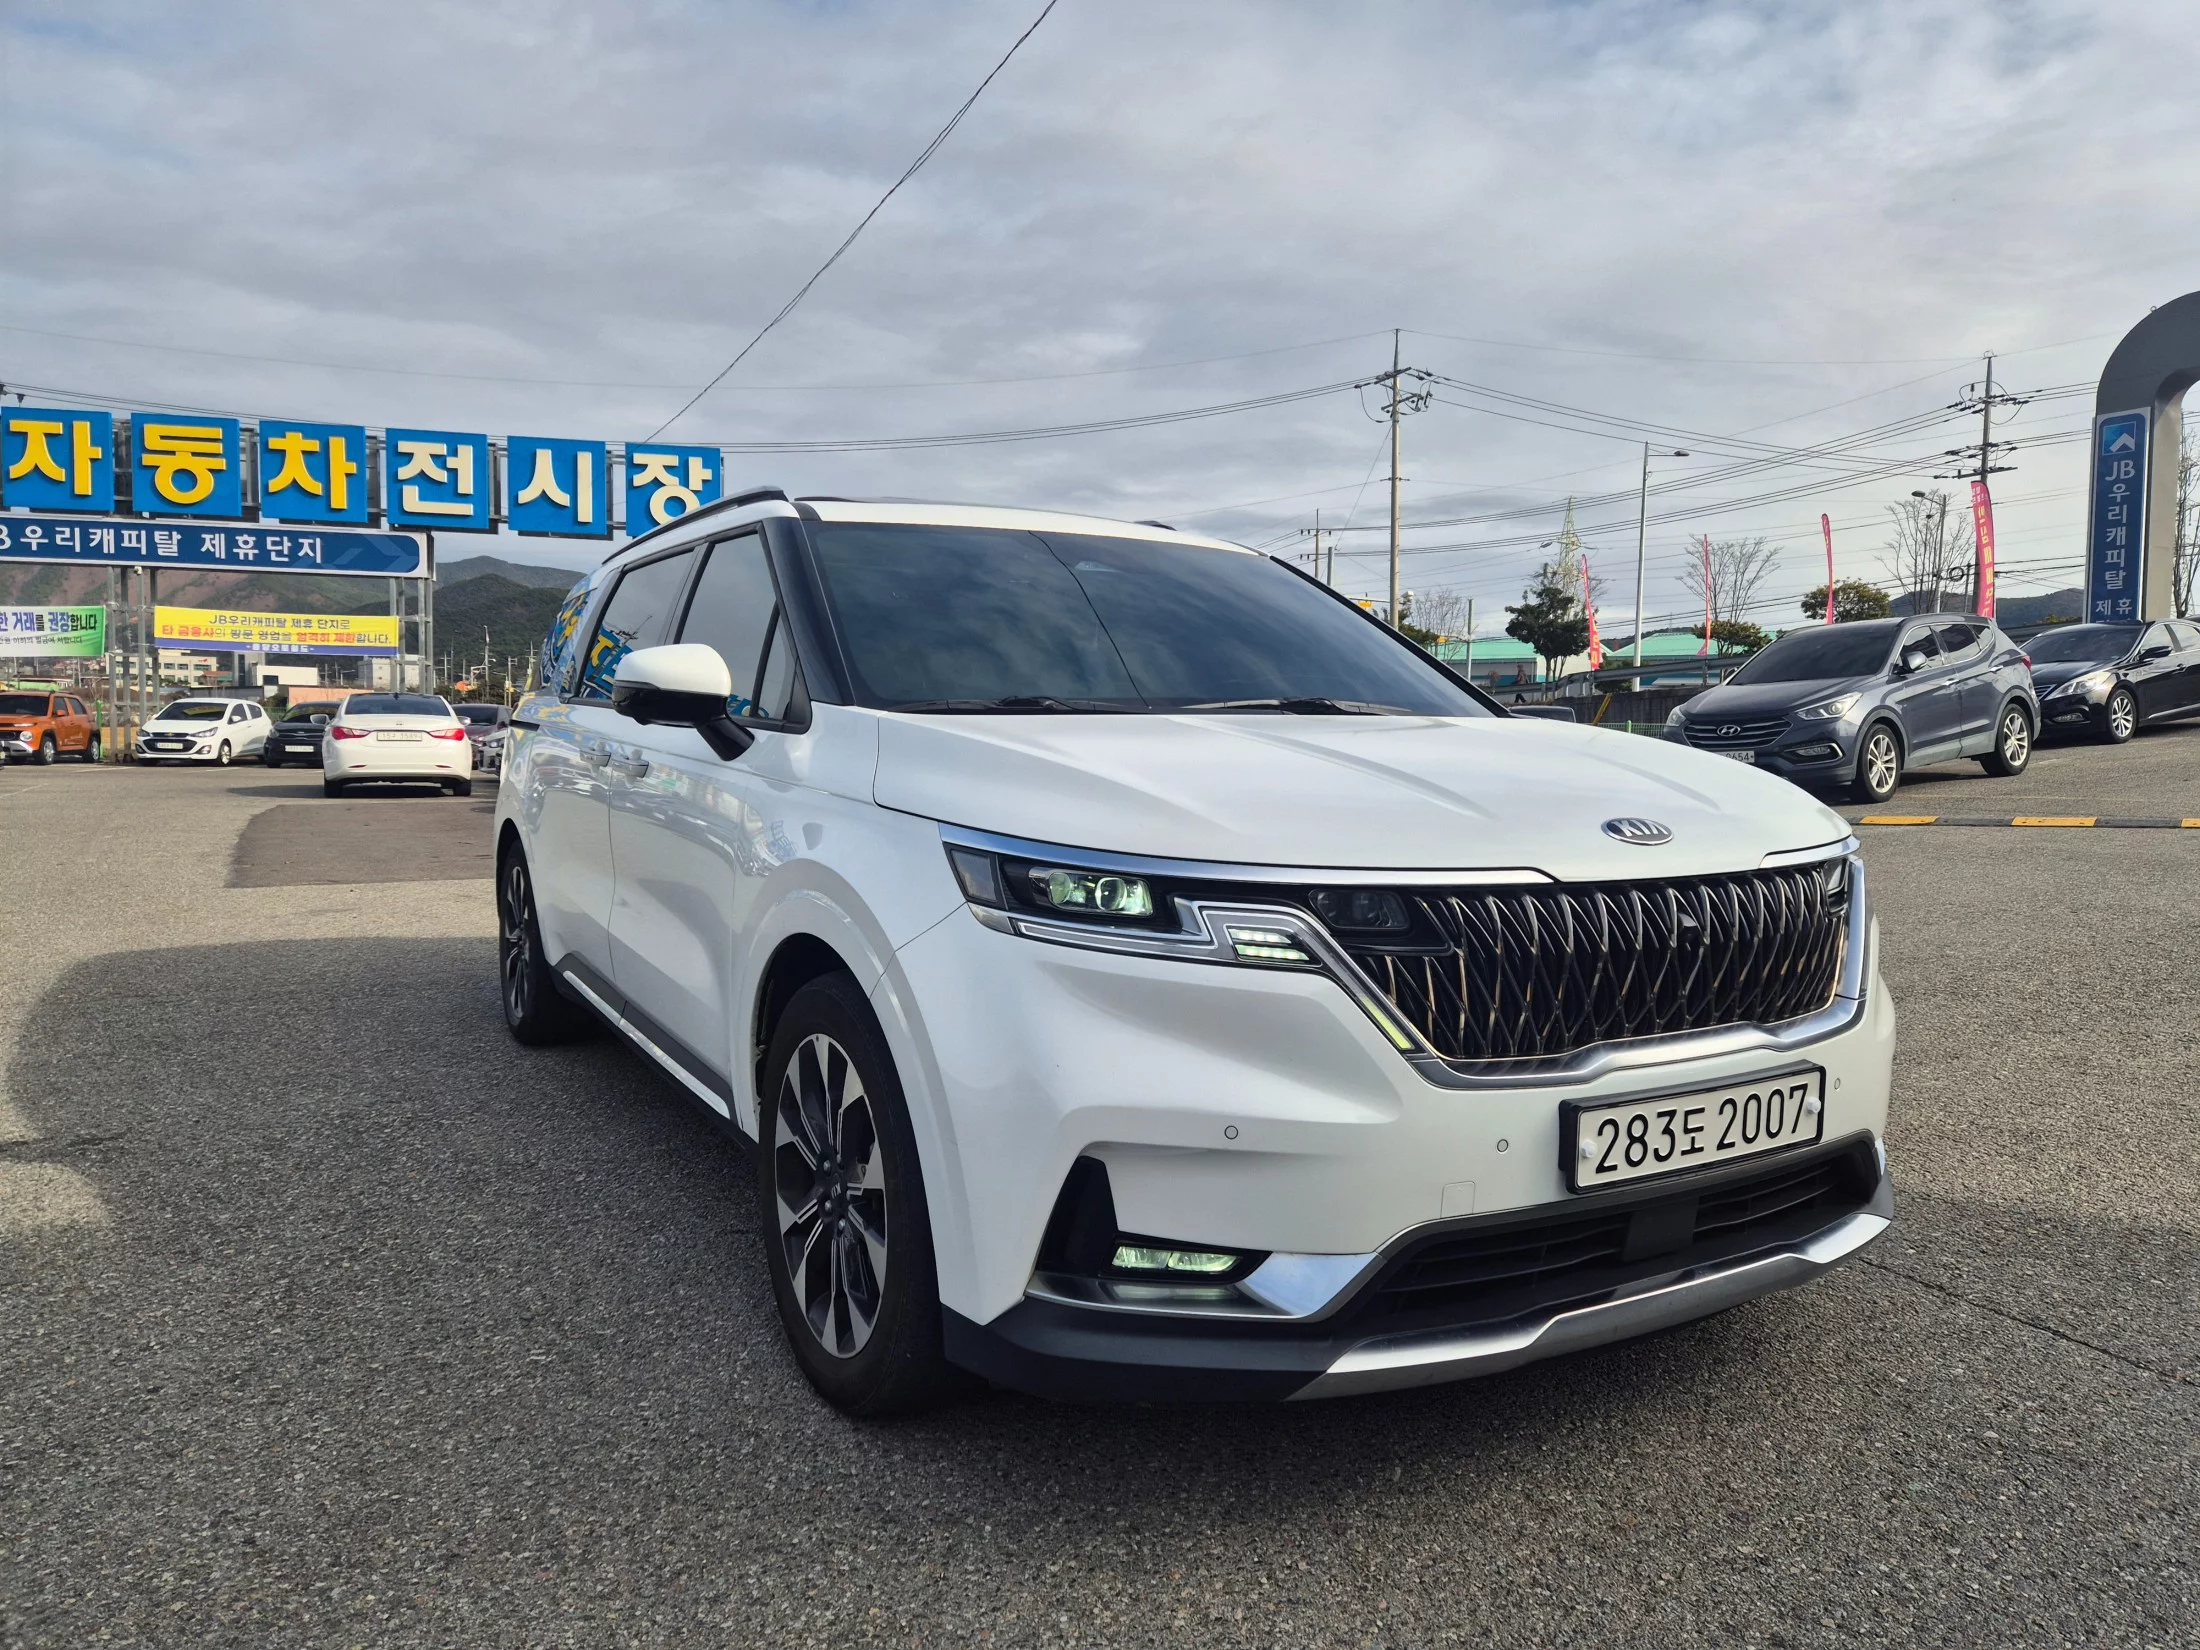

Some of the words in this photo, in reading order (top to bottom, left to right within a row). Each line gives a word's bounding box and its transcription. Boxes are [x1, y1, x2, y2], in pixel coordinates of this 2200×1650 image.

[200, 532, 322, 564] 제휴단지
[12, 612, 45, 632] 거래를
[48, 611, 97, 632] 권장합니다
[209, 615, 287, 628] JB우리캐피탈
[291, 618, 313, 629] 제휴
[317, 619, 351, 630] 단지로
[1595, 1107, 1706, 1175] 283도
[1716, 1083, 1809, 1151] 2007
